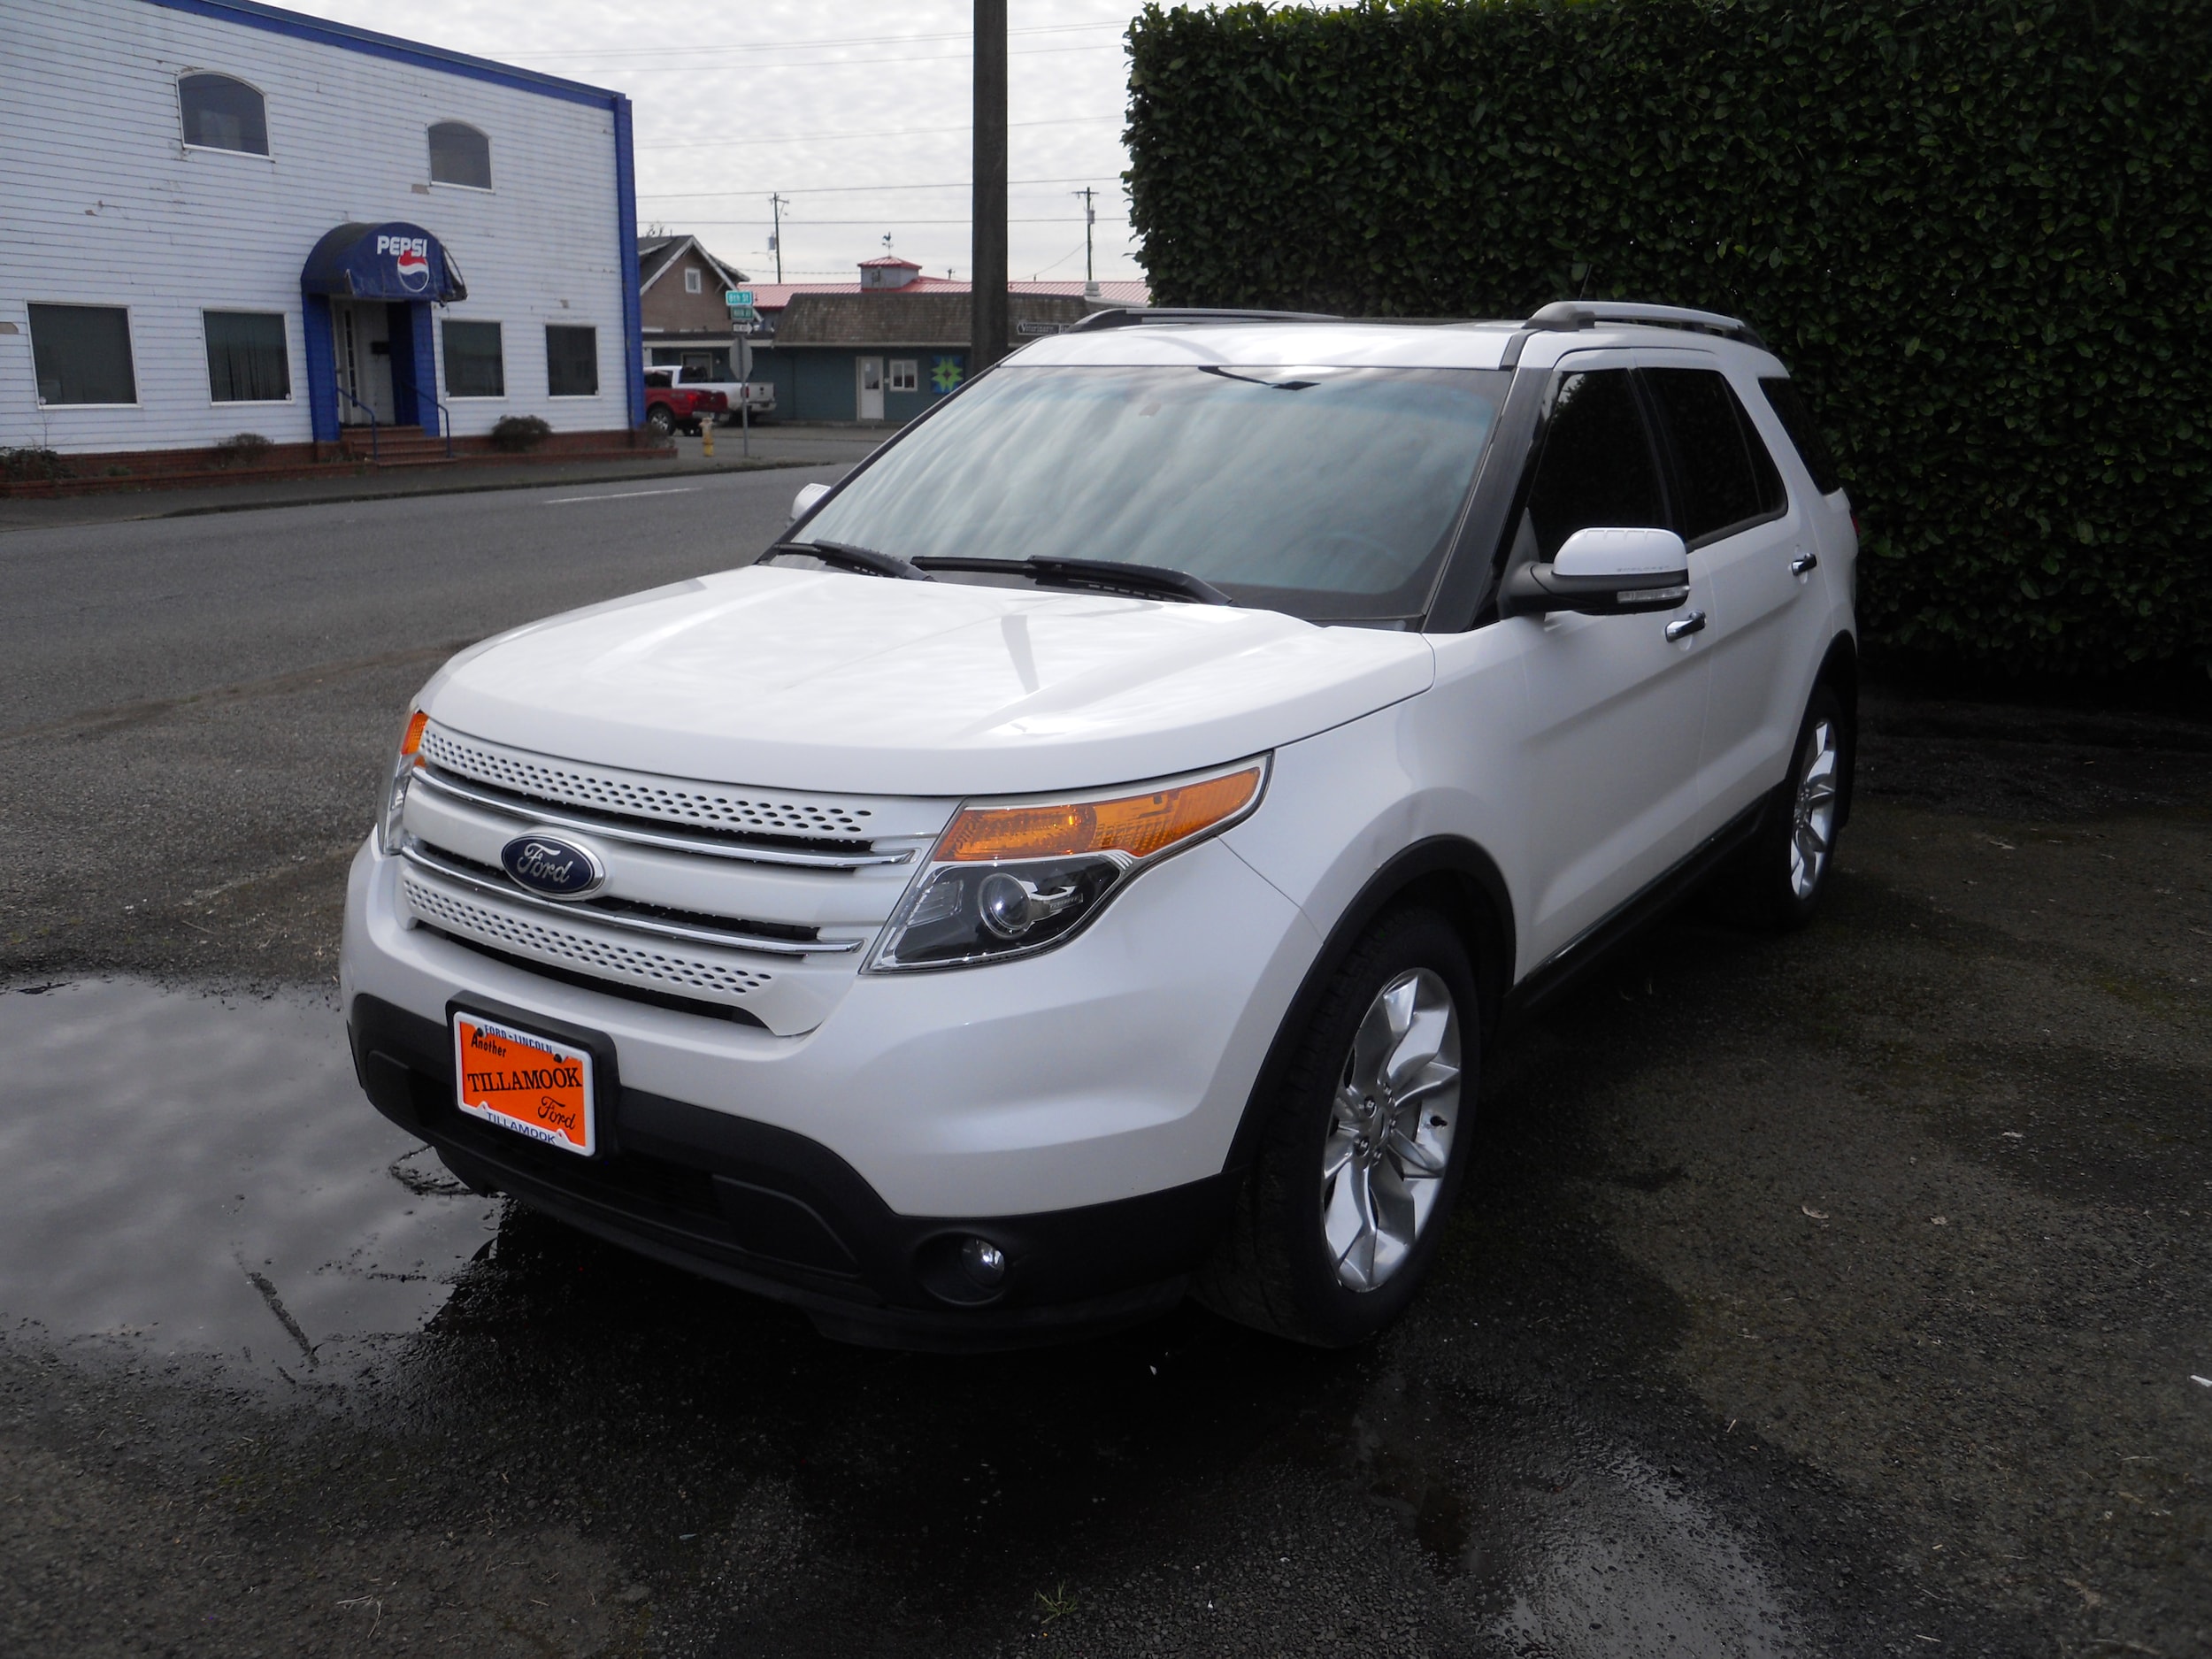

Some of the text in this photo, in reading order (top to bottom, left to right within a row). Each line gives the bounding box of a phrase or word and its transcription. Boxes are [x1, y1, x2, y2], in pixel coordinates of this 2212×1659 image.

[376, 234, 428, 257] PEPSI
[517, 842, 574, 884] Ford
[471, 1031, 507, 1057] Another
[467, 1067, 583, 1093] TILLAMOOK
[486, 1111, 557, 1145] TILLAMOOK
[537, 1095, 577, 1131] Ford
